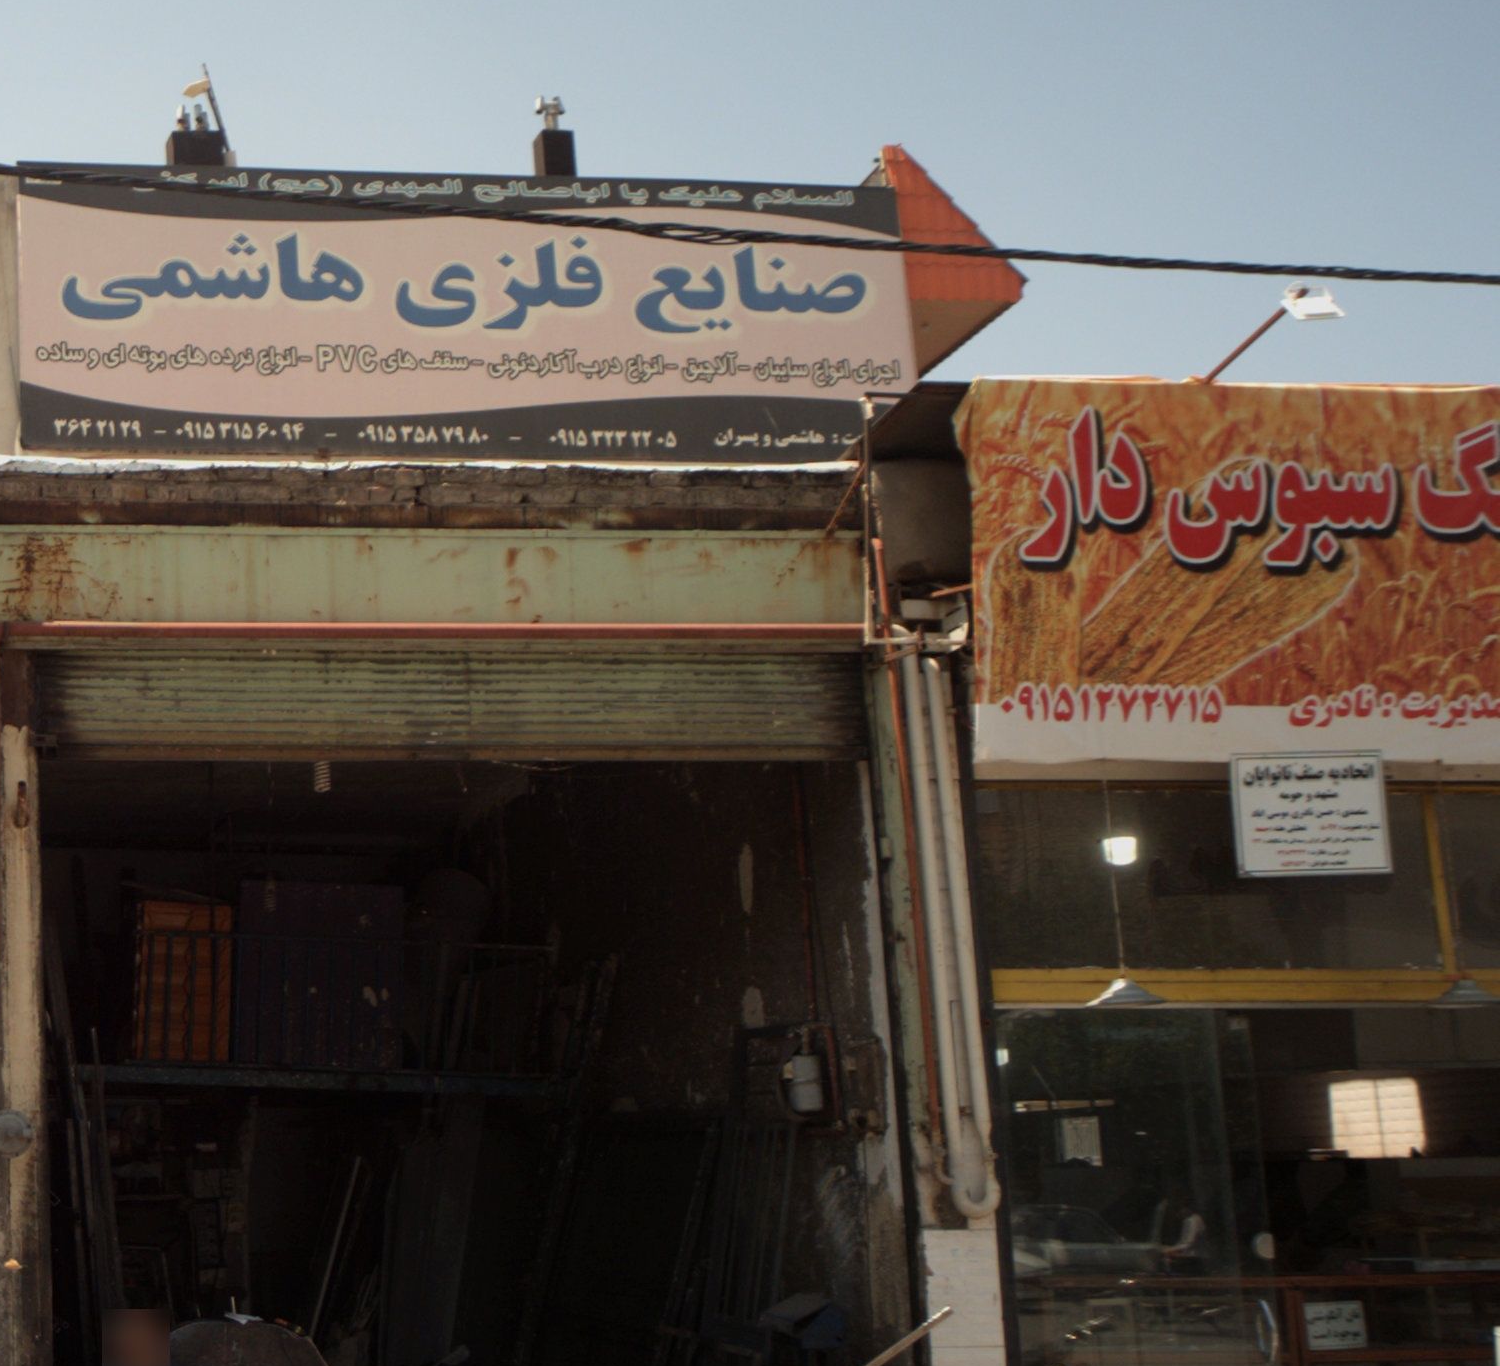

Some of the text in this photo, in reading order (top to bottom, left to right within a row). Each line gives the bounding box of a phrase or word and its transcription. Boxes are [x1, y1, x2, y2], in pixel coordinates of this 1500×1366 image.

[353, 177, 463, 199] المهدی
[620, 183, 648, 205] یا
[753, 188, 856, 210] السلام
[61, 232, 869, 333] صنایع فلزی هاشمی
[36, 342, 85, 362] ساده
[86, 348, 99, 370] و
[102, 343, 127, 368] ای
[129, 345, 167, 372] بوته
[169, 344, 208, 370] های
[209, 347, 255, 372] نرده
[256, 346, 298, 375] انواع
[316, 344, 378, 373] PVC
[379, 349, 418, 375] های
[420, 350, 469, 370] سقف
[578, 354, 622, 379] درب
[625, 354, 664, 385] انواع
[682, 352, 738, 383] آلاچیق
[753, 357, 809, 383] سایبان
[812, 359, 850, 388] انواع
[852, 359, 901, 385] اجرای
[762, 433, 771, 446] و
[775, 428, 825, 447] هاشمی
[1021, 406, 1147, 564] دار
[1167, 457, 1396, 567] سبوس
[1289, 685, 1376, 728] نادری
